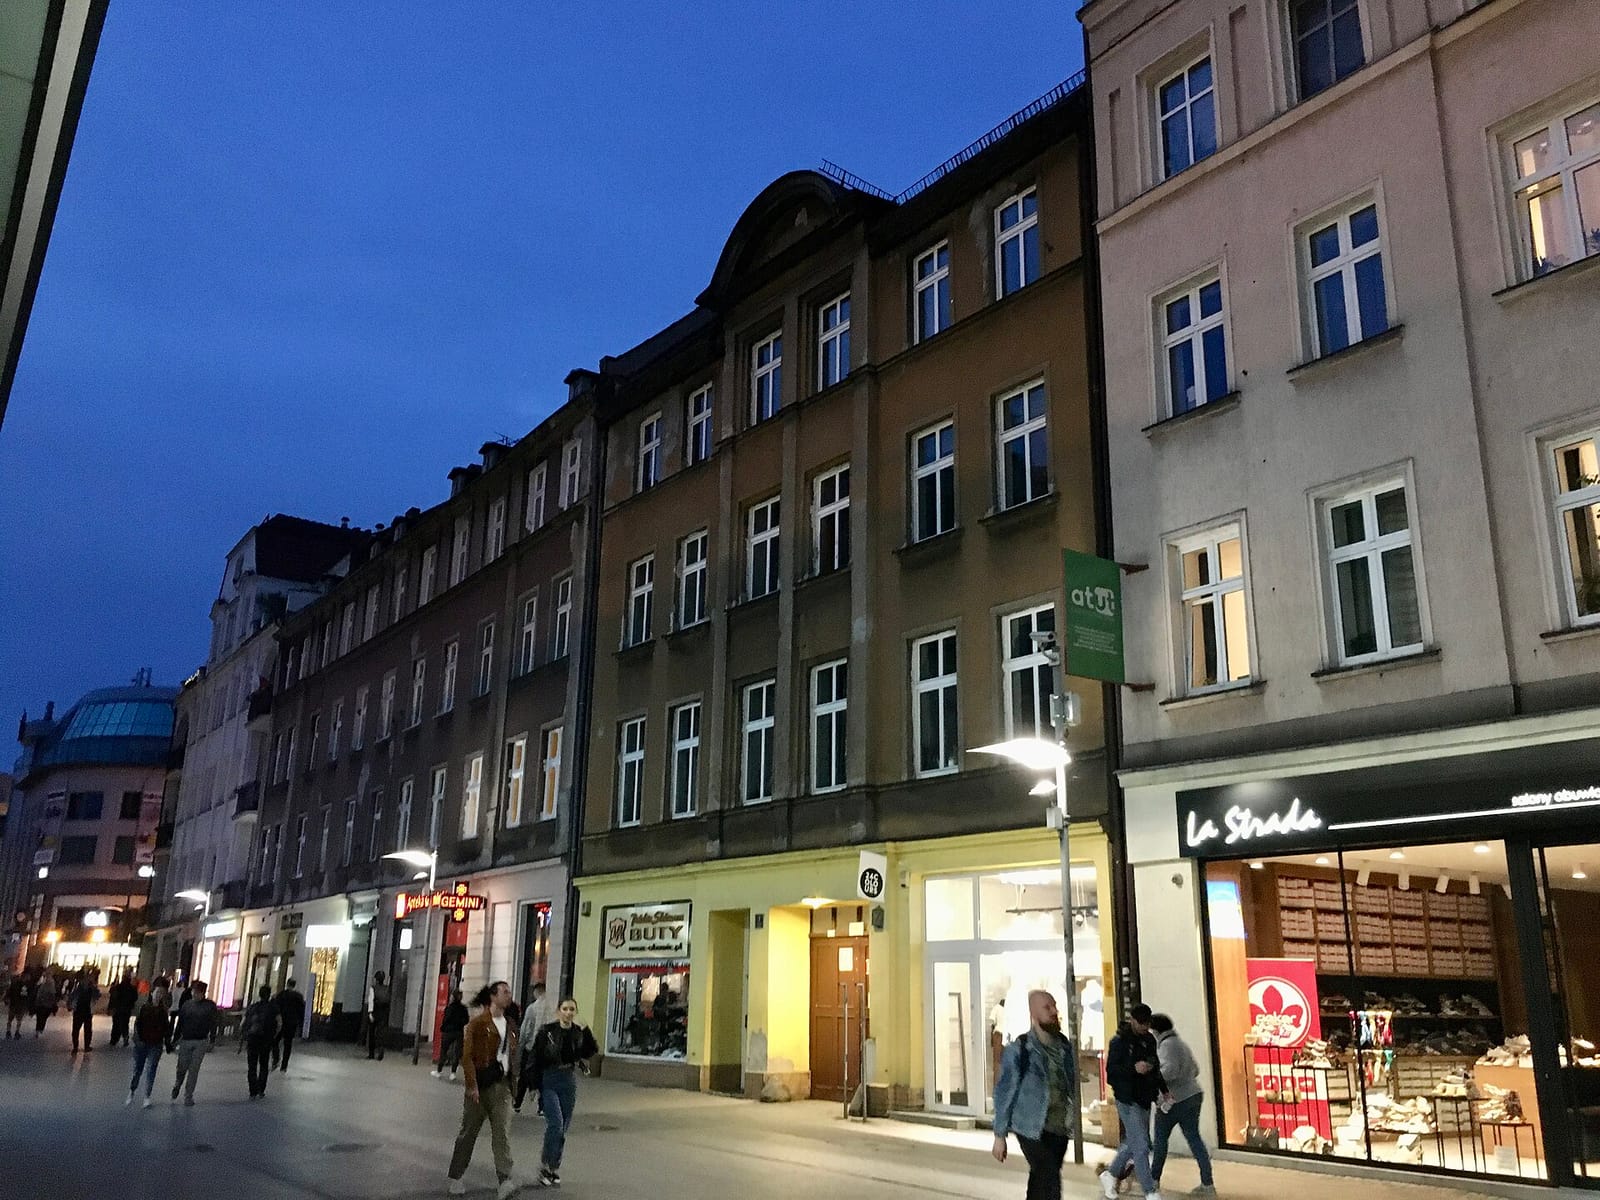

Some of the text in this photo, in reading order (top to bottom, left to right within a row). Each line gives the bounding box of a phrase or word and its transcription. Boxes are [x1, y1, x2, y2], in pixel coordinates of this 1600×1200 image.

[1511, 792, 1552, 807] salony
[1187, 797, 1322, 847] La Strada
[441, 896, 480, 909] GEMINI
[630, 925, 684, 941] BUTY
